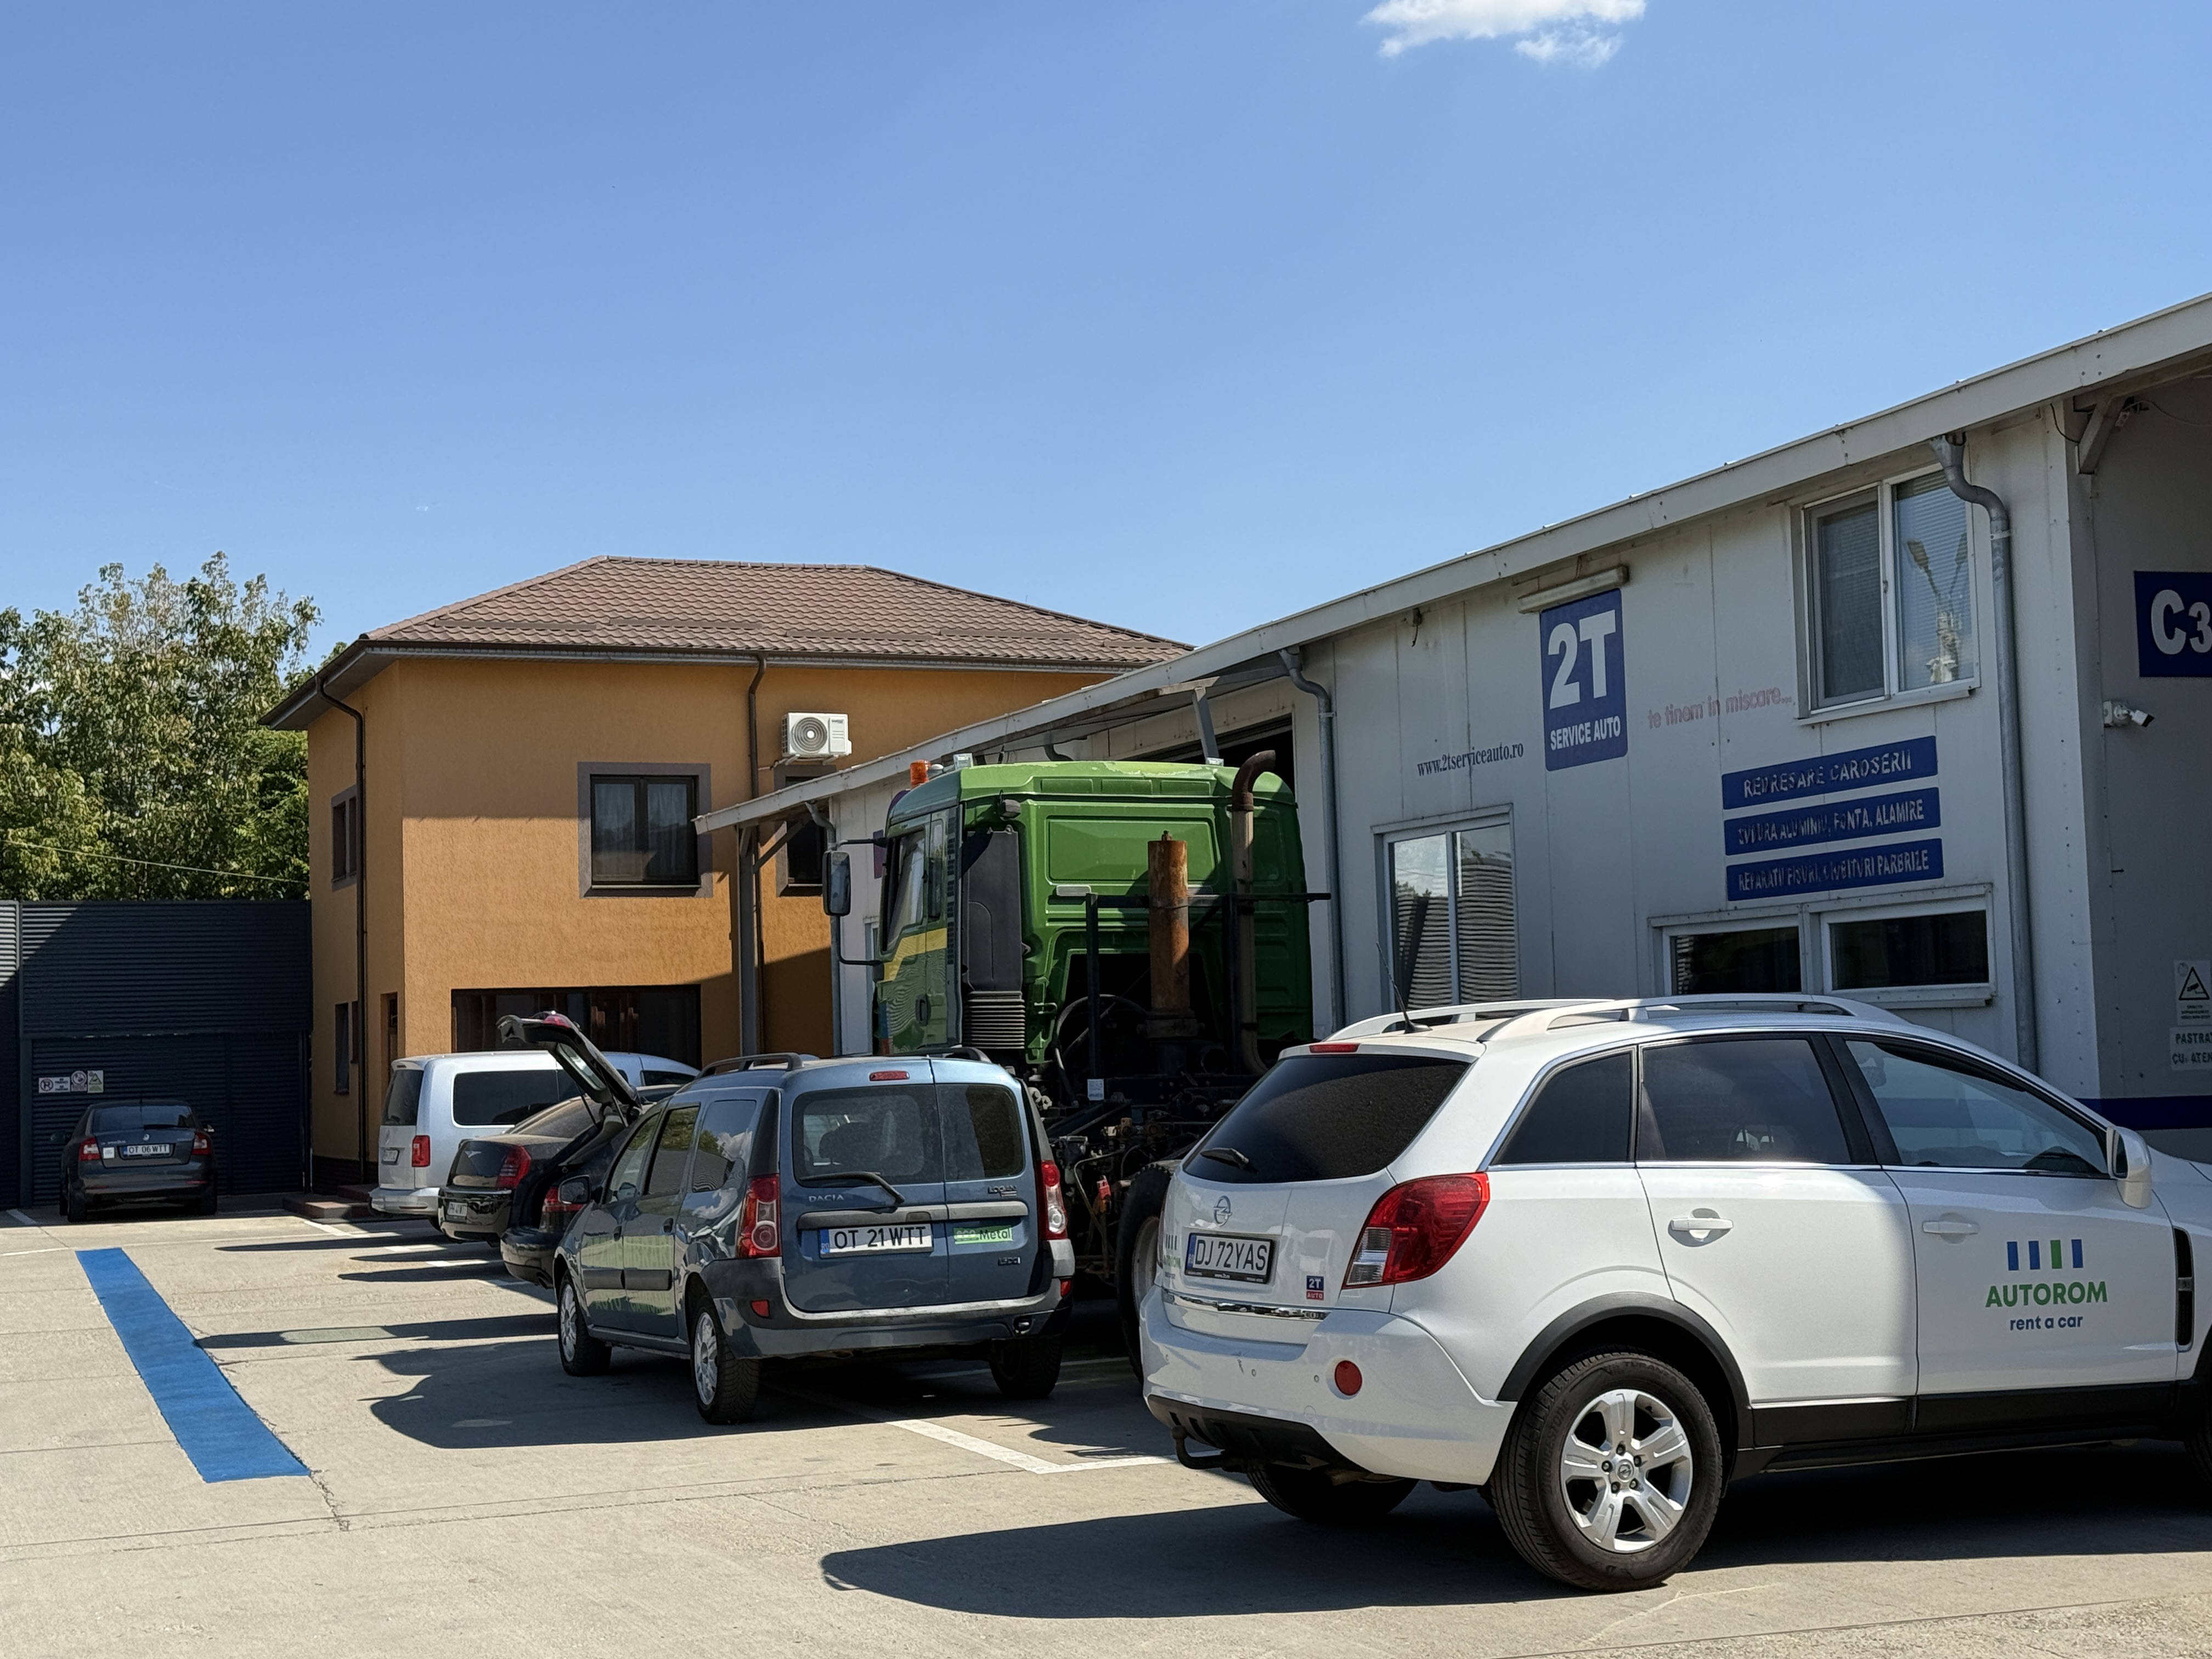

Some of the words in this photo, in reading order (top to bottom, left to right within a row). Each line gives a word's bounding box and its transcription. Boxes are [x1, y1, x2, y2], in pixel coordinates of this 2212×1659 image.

[2151, 589, 2212, 655] C3
[1548, 609, 1616, 710] 2T
[1550, 721, 1591, 751] SERVICE
[1593, 715, 1621, 742] AUTO
[1417, 742, 1524, 777] www.2tserviceauto.ro
[808, 1194, 844, 1203] DACIA
[1309, 1278, 1322, 1289] 2T
[1985, 1281, 2108, 1308] AUTOROM
[2010, 1315, 2041, 1331] rent
[2045, 1317, 2055, 1329] a
[2057, 1316, 2084, 1328] car
